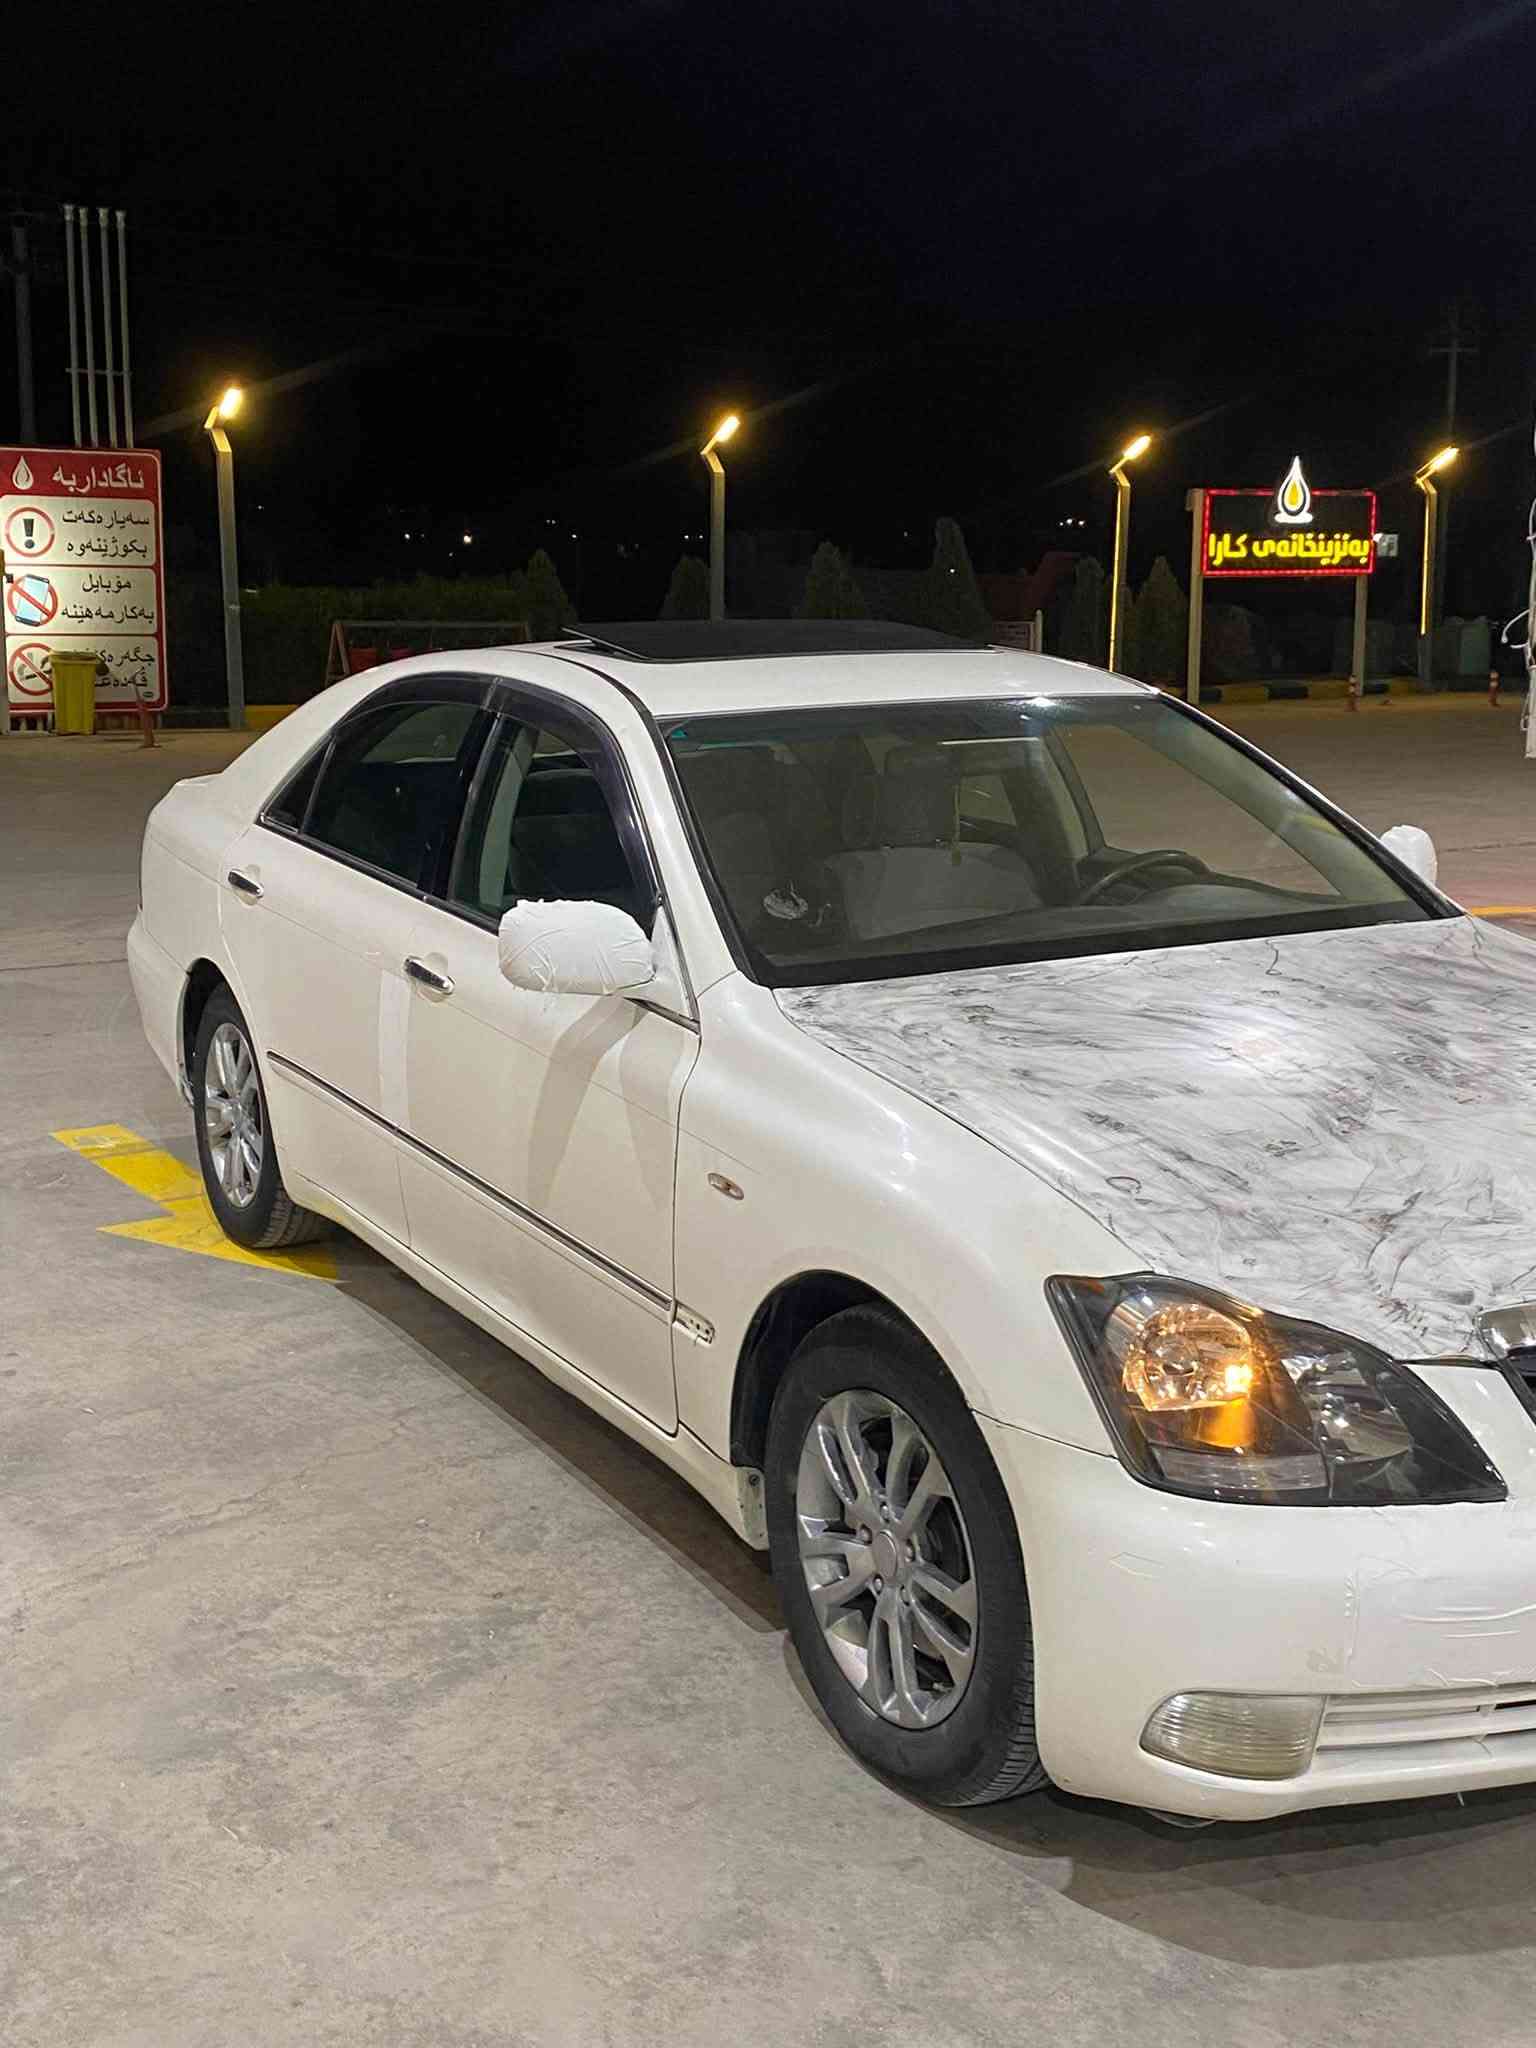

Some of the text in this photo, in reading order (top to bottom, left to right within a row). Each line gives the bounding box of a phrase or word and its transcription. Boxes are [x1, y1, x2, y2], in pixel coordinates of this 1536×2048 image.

[1208, 532, 1370, 566] بەنزینخانەی کارا
[82, 573, 132, 594] مۆبایل
